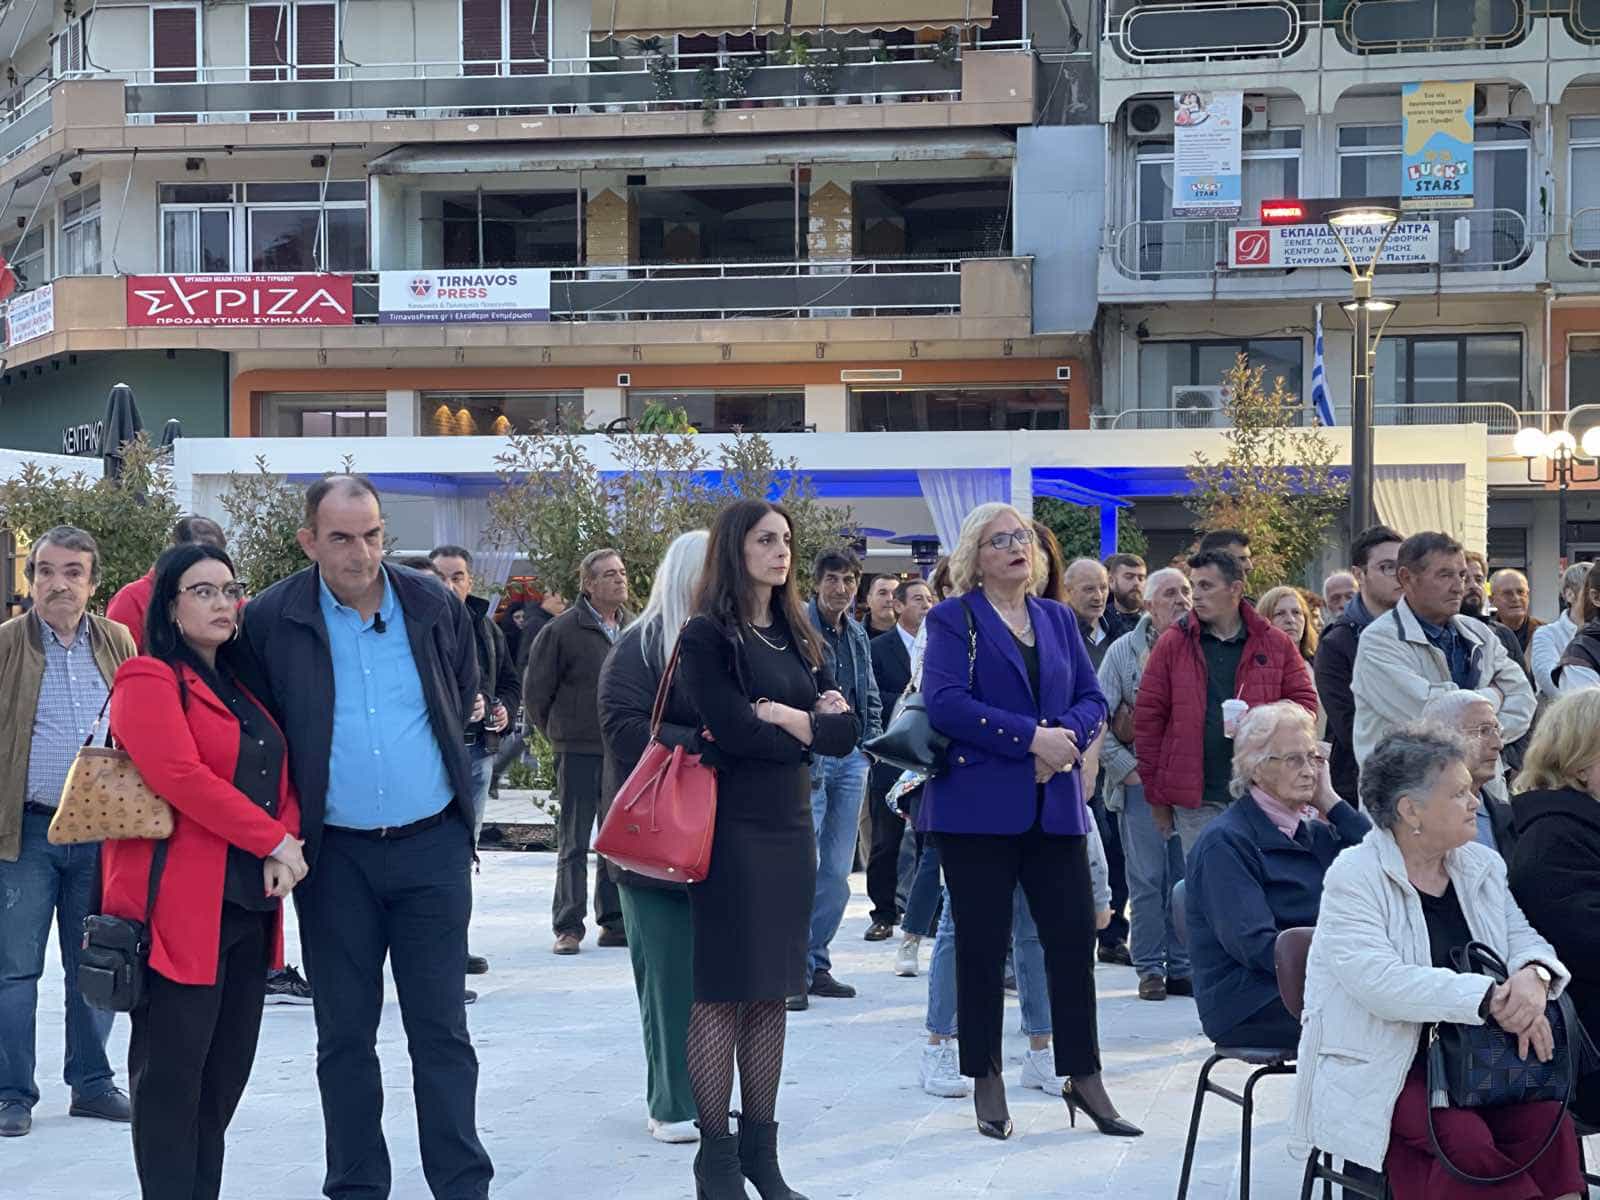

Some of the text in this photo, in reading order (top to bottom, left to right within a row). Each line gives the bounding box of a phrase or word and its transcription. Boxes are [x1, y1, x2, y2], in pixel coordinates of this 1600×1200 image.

[1408, 162, 1468, 180] LUCKY
[1415, 180, 1461, 192] STARS
[1284, 238, 1312, 247] ΞΕΝΕΣ
[1316, 236, 1355, 246] ΓΛΩΣΕΣ
[1361, 235, 1428, 245] ΠΛΗΟΦΟΡΙΚΗ
[1284, 247, 1320, 256] ΚΕΝΤΡΟ
[1369, 243, 1411, 253] ΜΘΗΣΗΣ
[437, 274, 518, 287] TIRNAVOS
[134, 276, 346, 316] ΣΥΡΙΖΑ
[437, 287, 488, 299] PRESS
[254, 316, 322, 324] ΣΥΜΜΑΧΙΑ
[389, 313, 449, 322] TirnavosPress.gr
